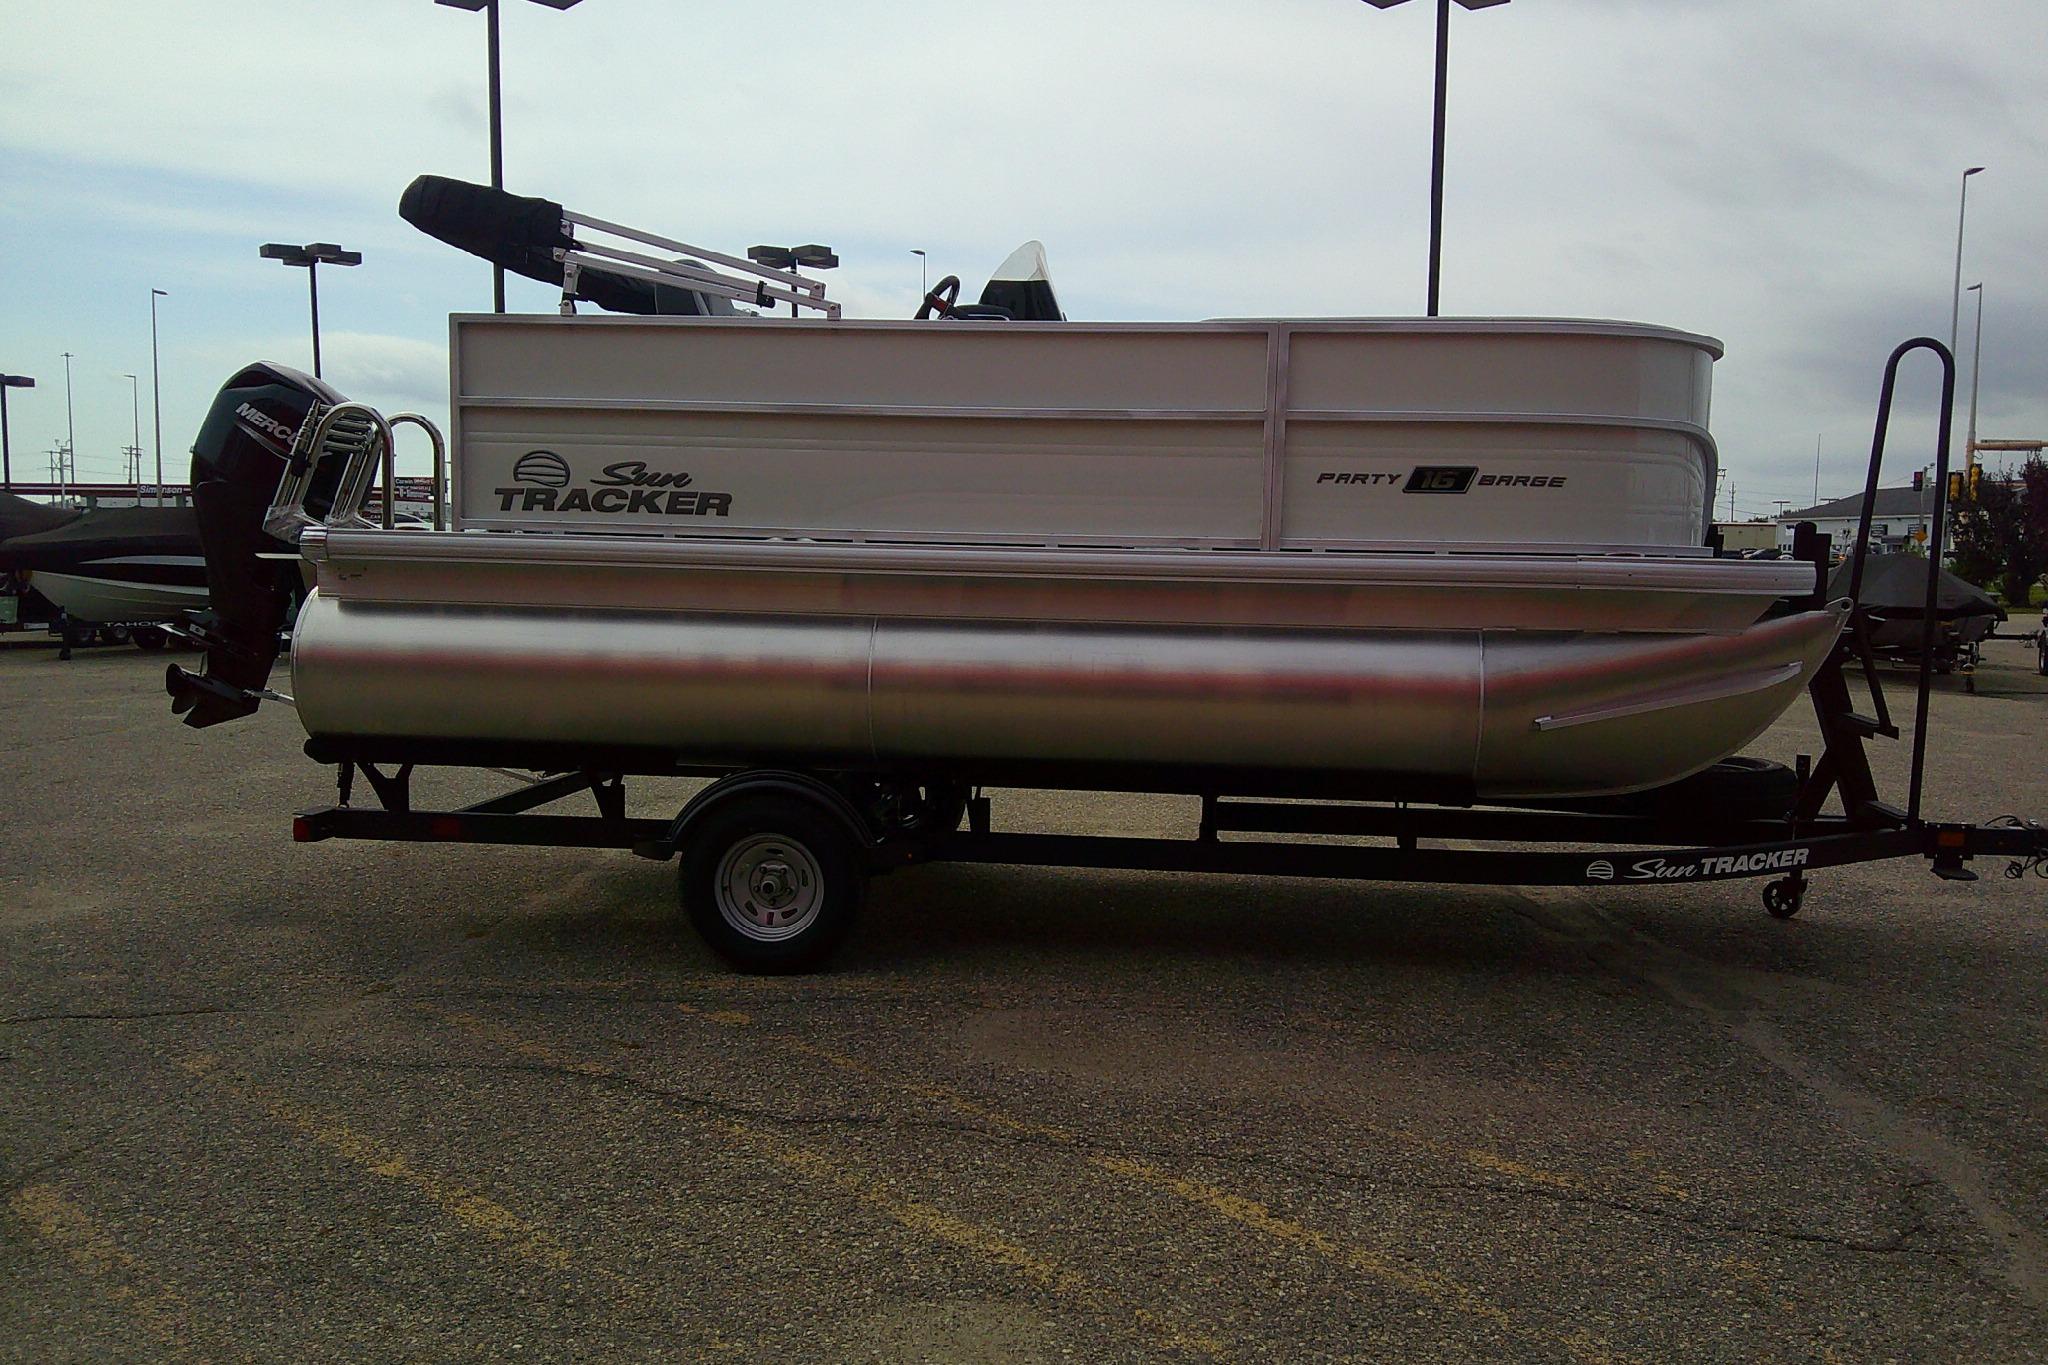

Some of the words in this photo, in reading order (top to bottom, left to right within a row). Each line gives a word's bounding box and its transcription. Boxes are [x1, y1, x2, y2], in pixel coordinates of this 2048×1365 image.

[234, 402, 298, 446] MERCU
[590, 461, 693, 488] Sun
[1316, 472, 1403, 485] PARTY
[1477, 474, 1568, 487] BARGE
[139, 485, 183, 494] Simnson
[494, 487, 733, 517] TRACKER
[1623, 858, 1698, 879] Sun
[1700, 848, 1810, 875] TRACKER
